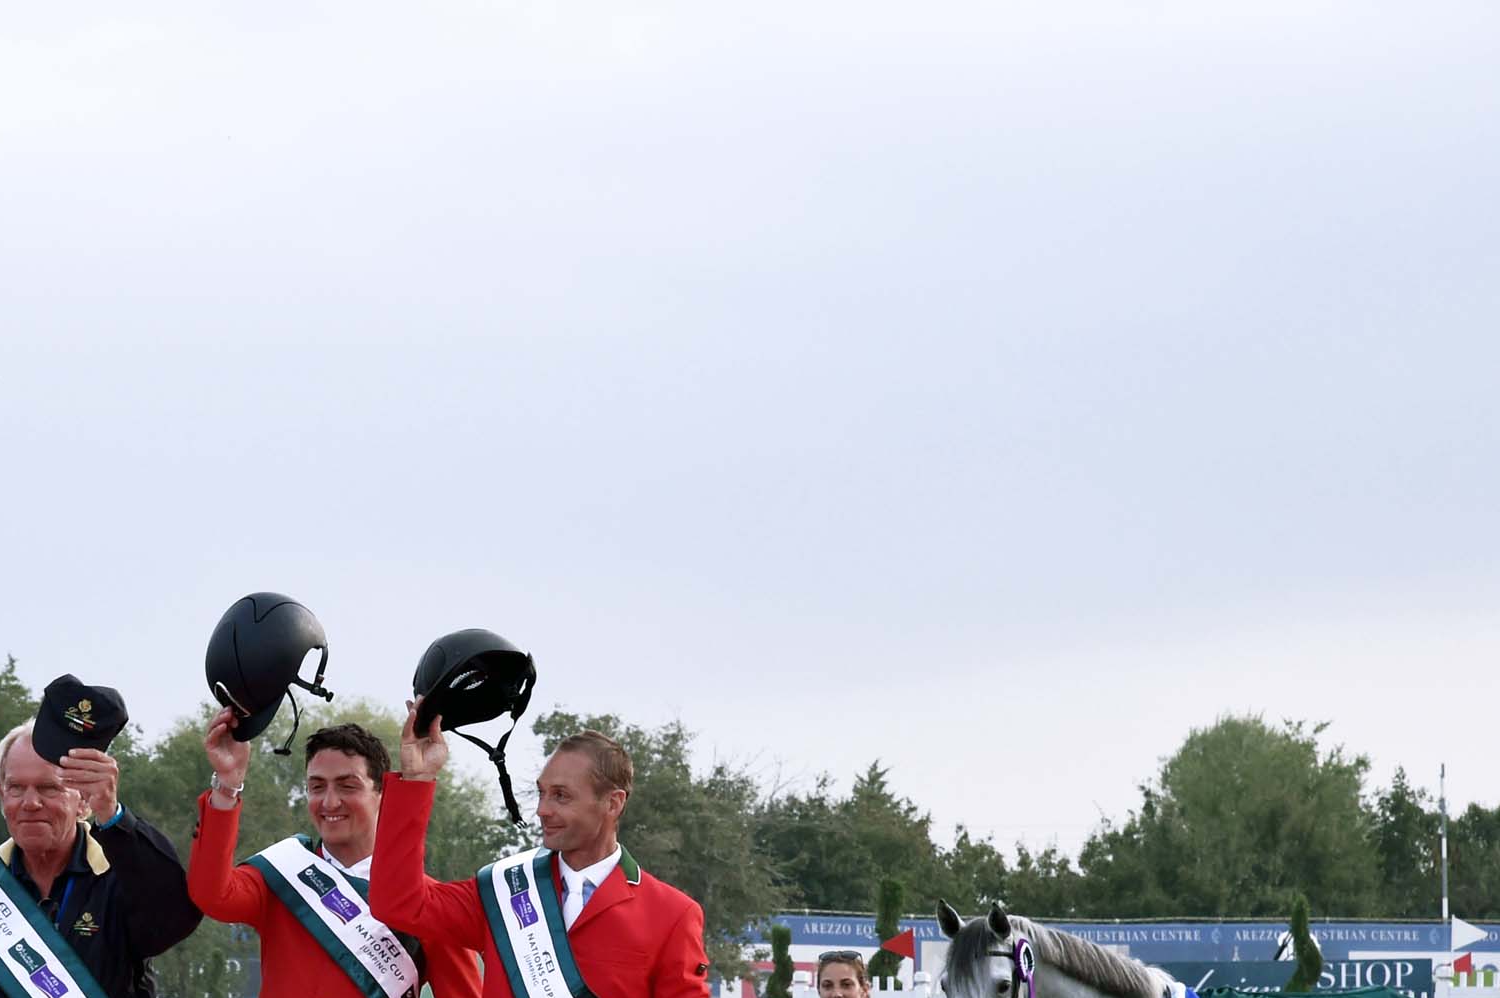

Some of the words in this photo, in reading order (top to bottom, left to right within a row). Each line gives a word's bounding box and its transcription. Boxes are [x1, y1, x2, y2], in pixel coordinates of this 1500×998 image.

[0, 922, 13, 937] CUP
[802, 922, 851, 935] AREZZO
[1152, 930, 1201, 942] CENTRE
[1371, 930, 1420, 941] CENTRE
[355, 924, 390, 963] NATIONS
[390, 963, 405, 982] CUP
[360, 945, 388, 974] JUMPING
[527, 933, 546, 977] NATIONS
[541, 976, 554, 998] CUP
[1317, 962, 1414, 989] SHOP
